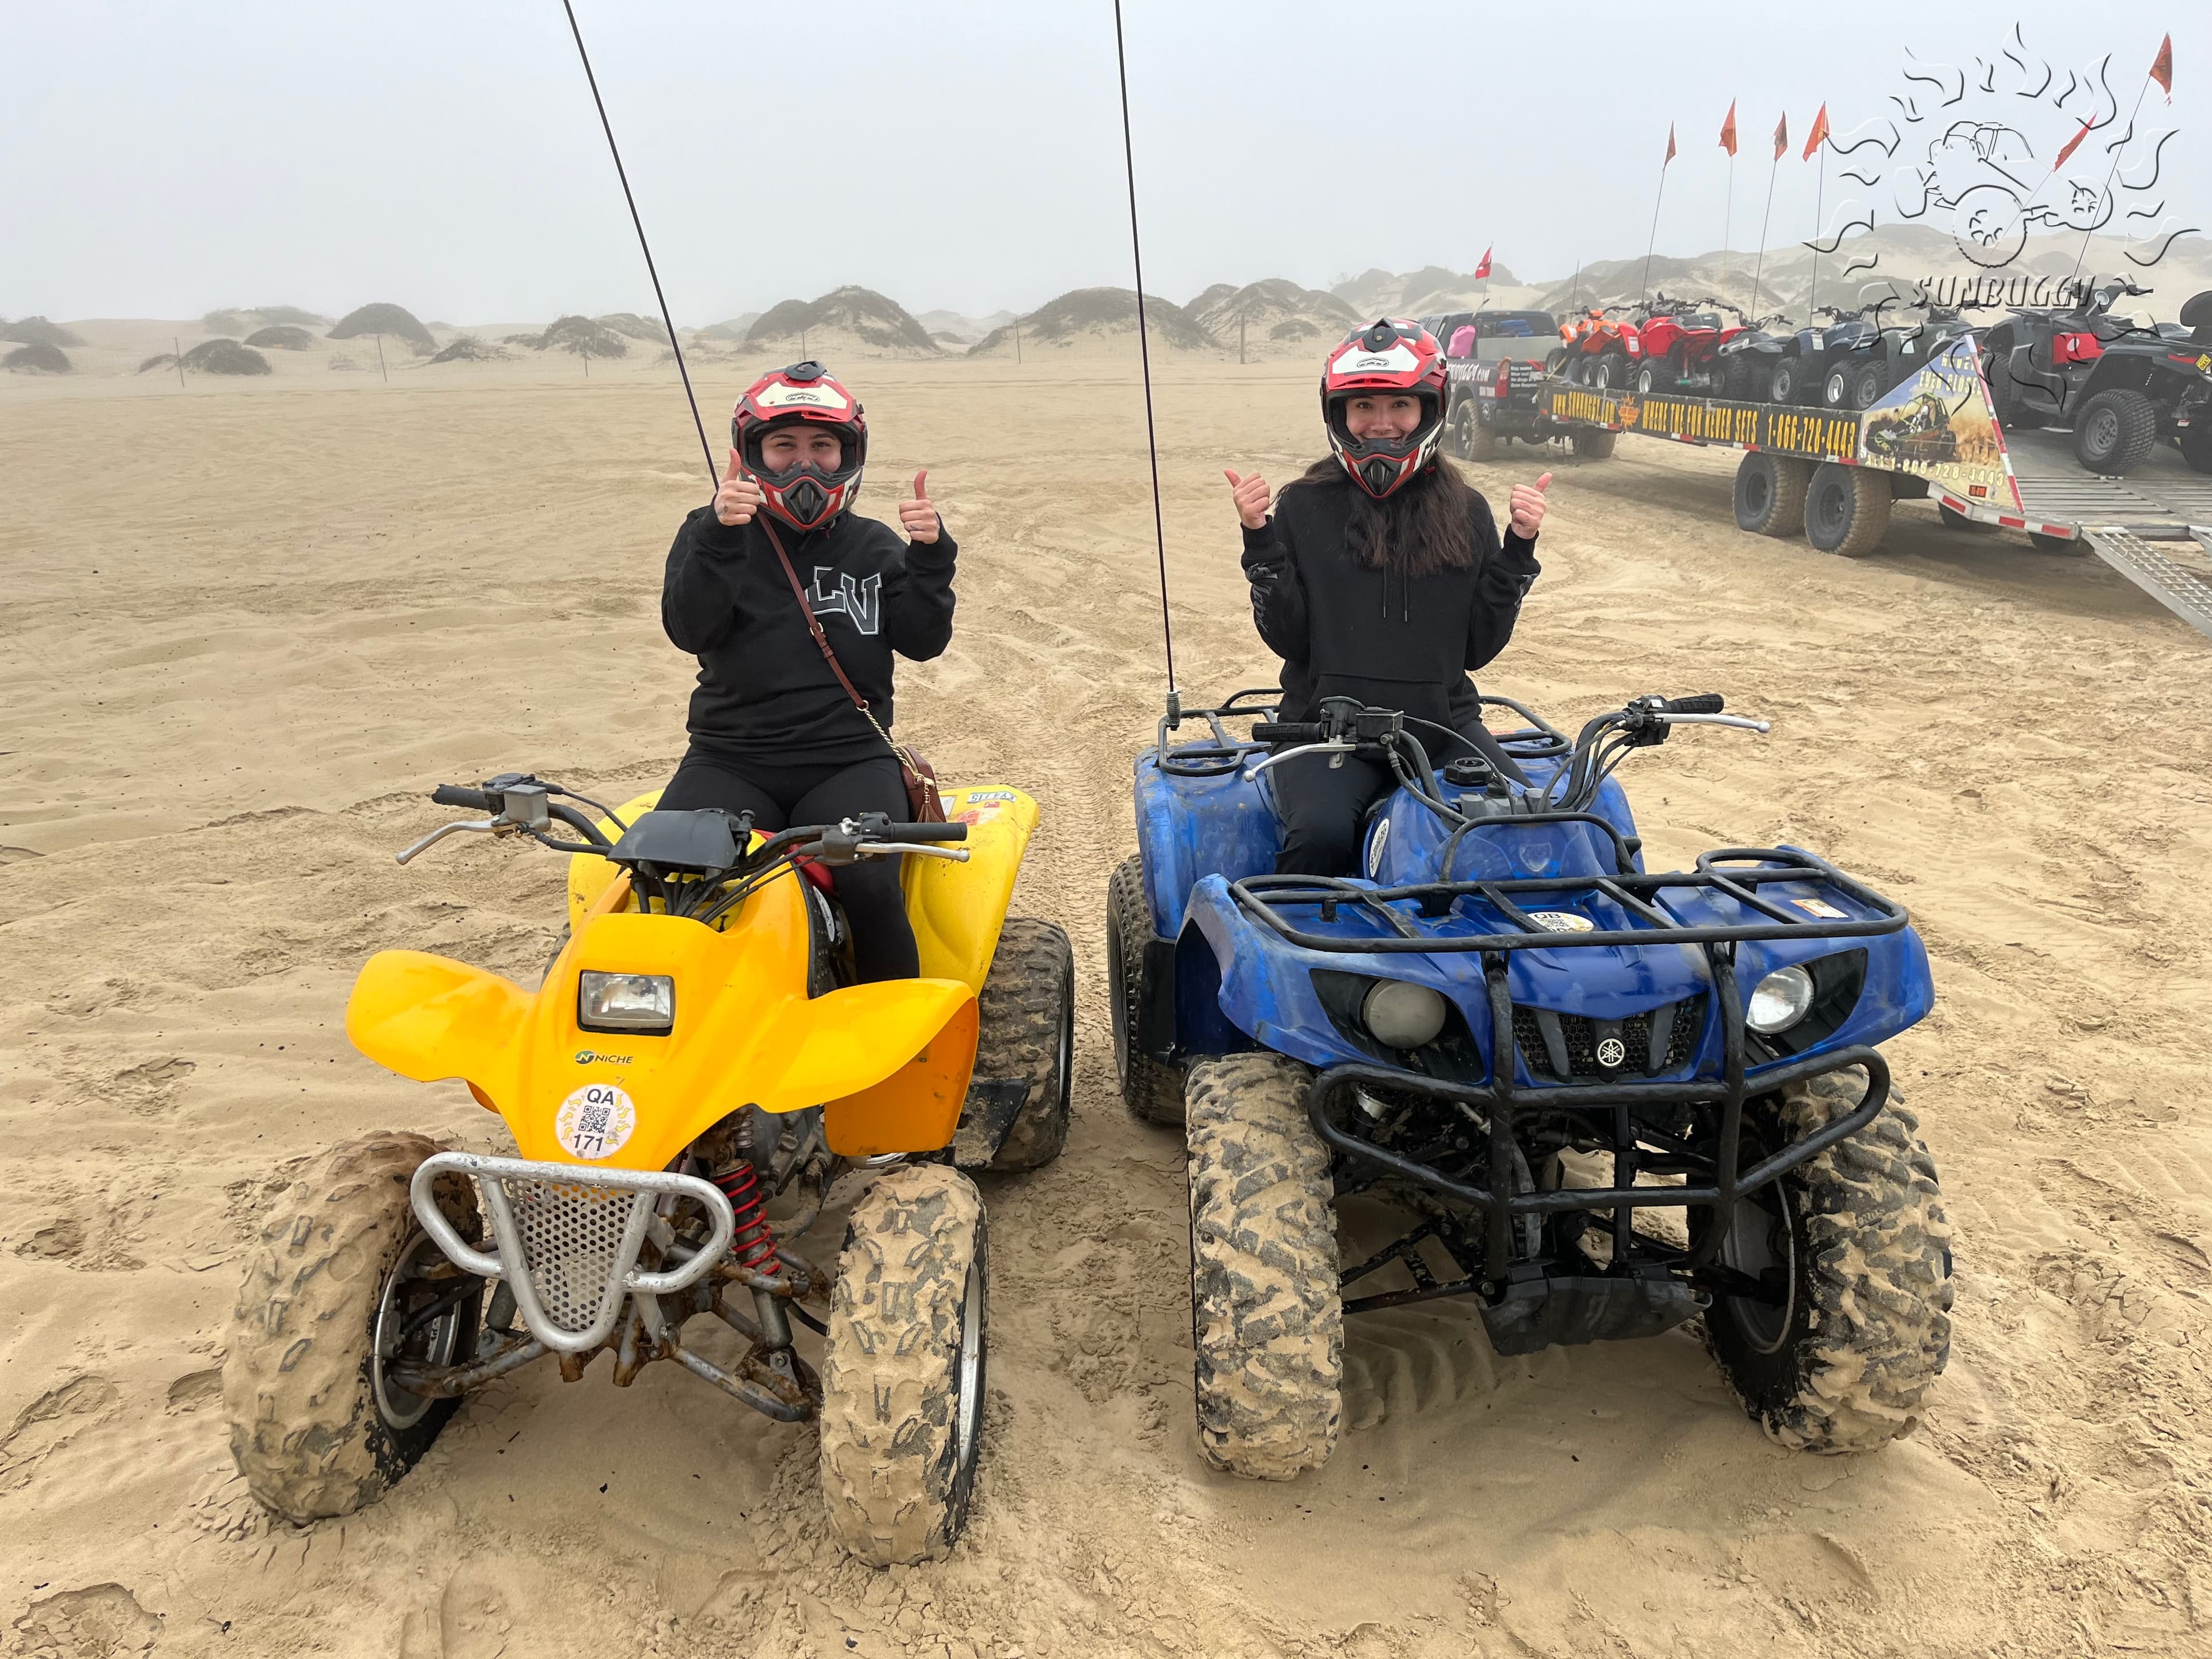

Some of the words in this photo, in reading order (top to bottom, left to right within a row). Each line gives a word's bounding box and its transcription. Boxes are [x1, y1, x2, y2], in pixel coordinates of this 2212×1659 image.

[1643, 400, 1668, 432] WHERE
[1671, 403, 1684, 434] THE
[1687, 405, 1702, 436] FUN
[1735, 409, 1758, 444] SETS
[1768, 413, 1855, 459] 1-866-728-4443
[805, 566, 882, 635] LV
[587, 1088, 614, 1105] QA
[574, 1134, 603, 1152] 171
